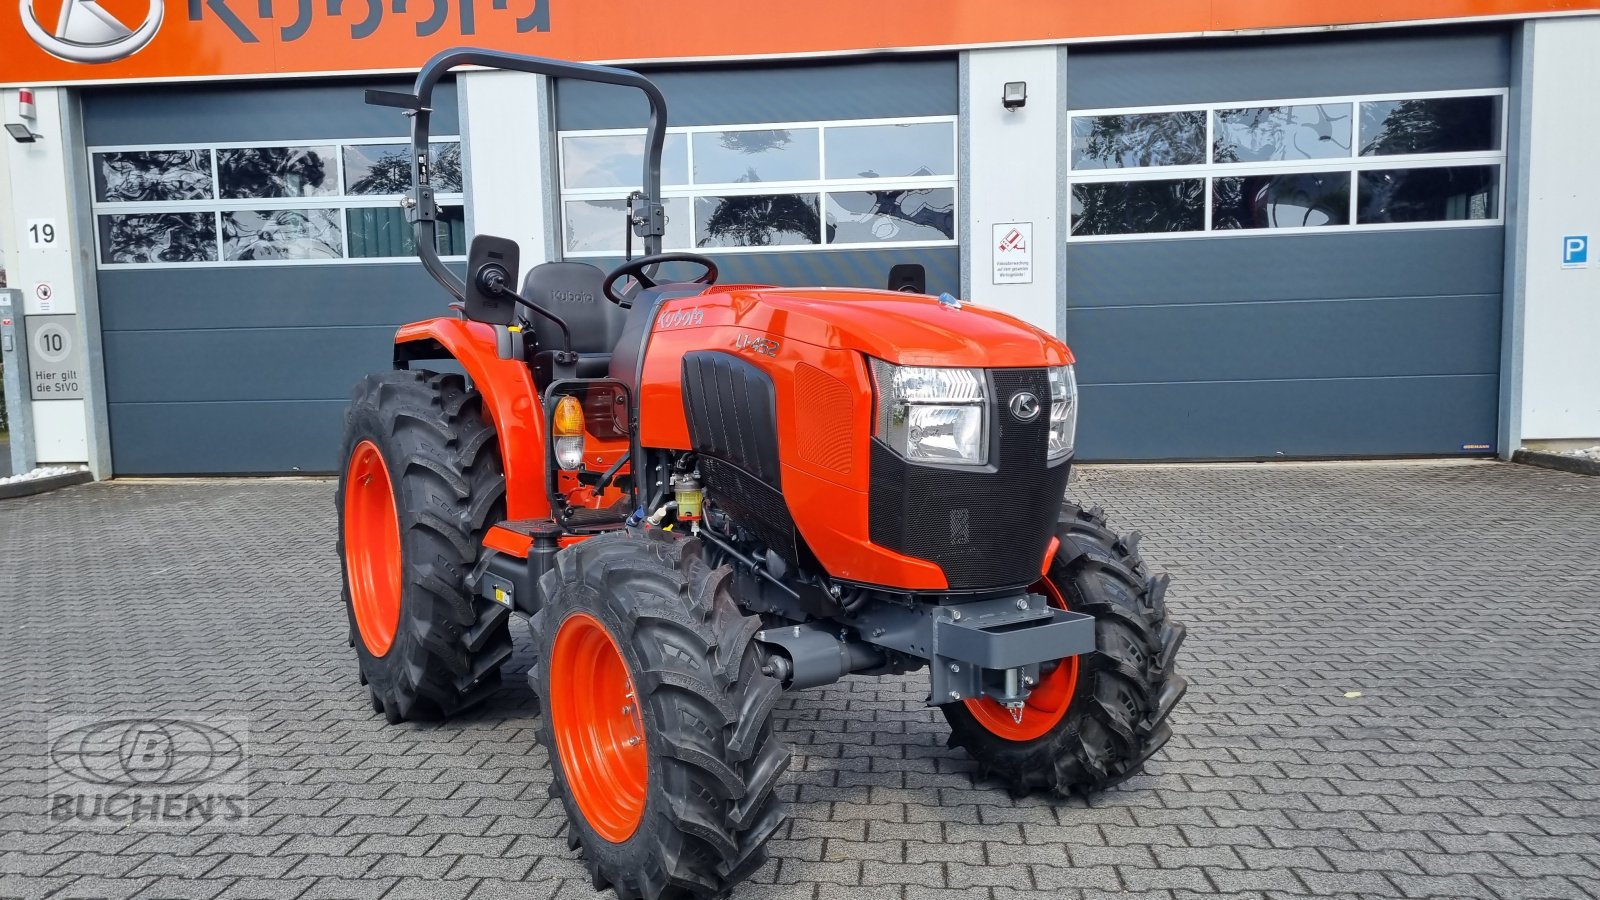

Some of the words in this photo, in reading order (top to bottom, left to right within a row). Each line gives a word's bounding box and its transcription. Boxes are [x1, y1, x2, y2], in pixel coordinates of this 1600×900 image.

[29, 223, 55, 244] 19
[1566, 239, 1585, 261] P
[551, 290, 594, 303] Kubota
[657, 306, 704, 329] Kubota
[43, 333, 63, 352] 10
[36, 370, 56, 380] Hier
[61, 370, 77, 382] gilt
[37, 383, 51, 392] die
[55, 382, 79, 392] StVO
